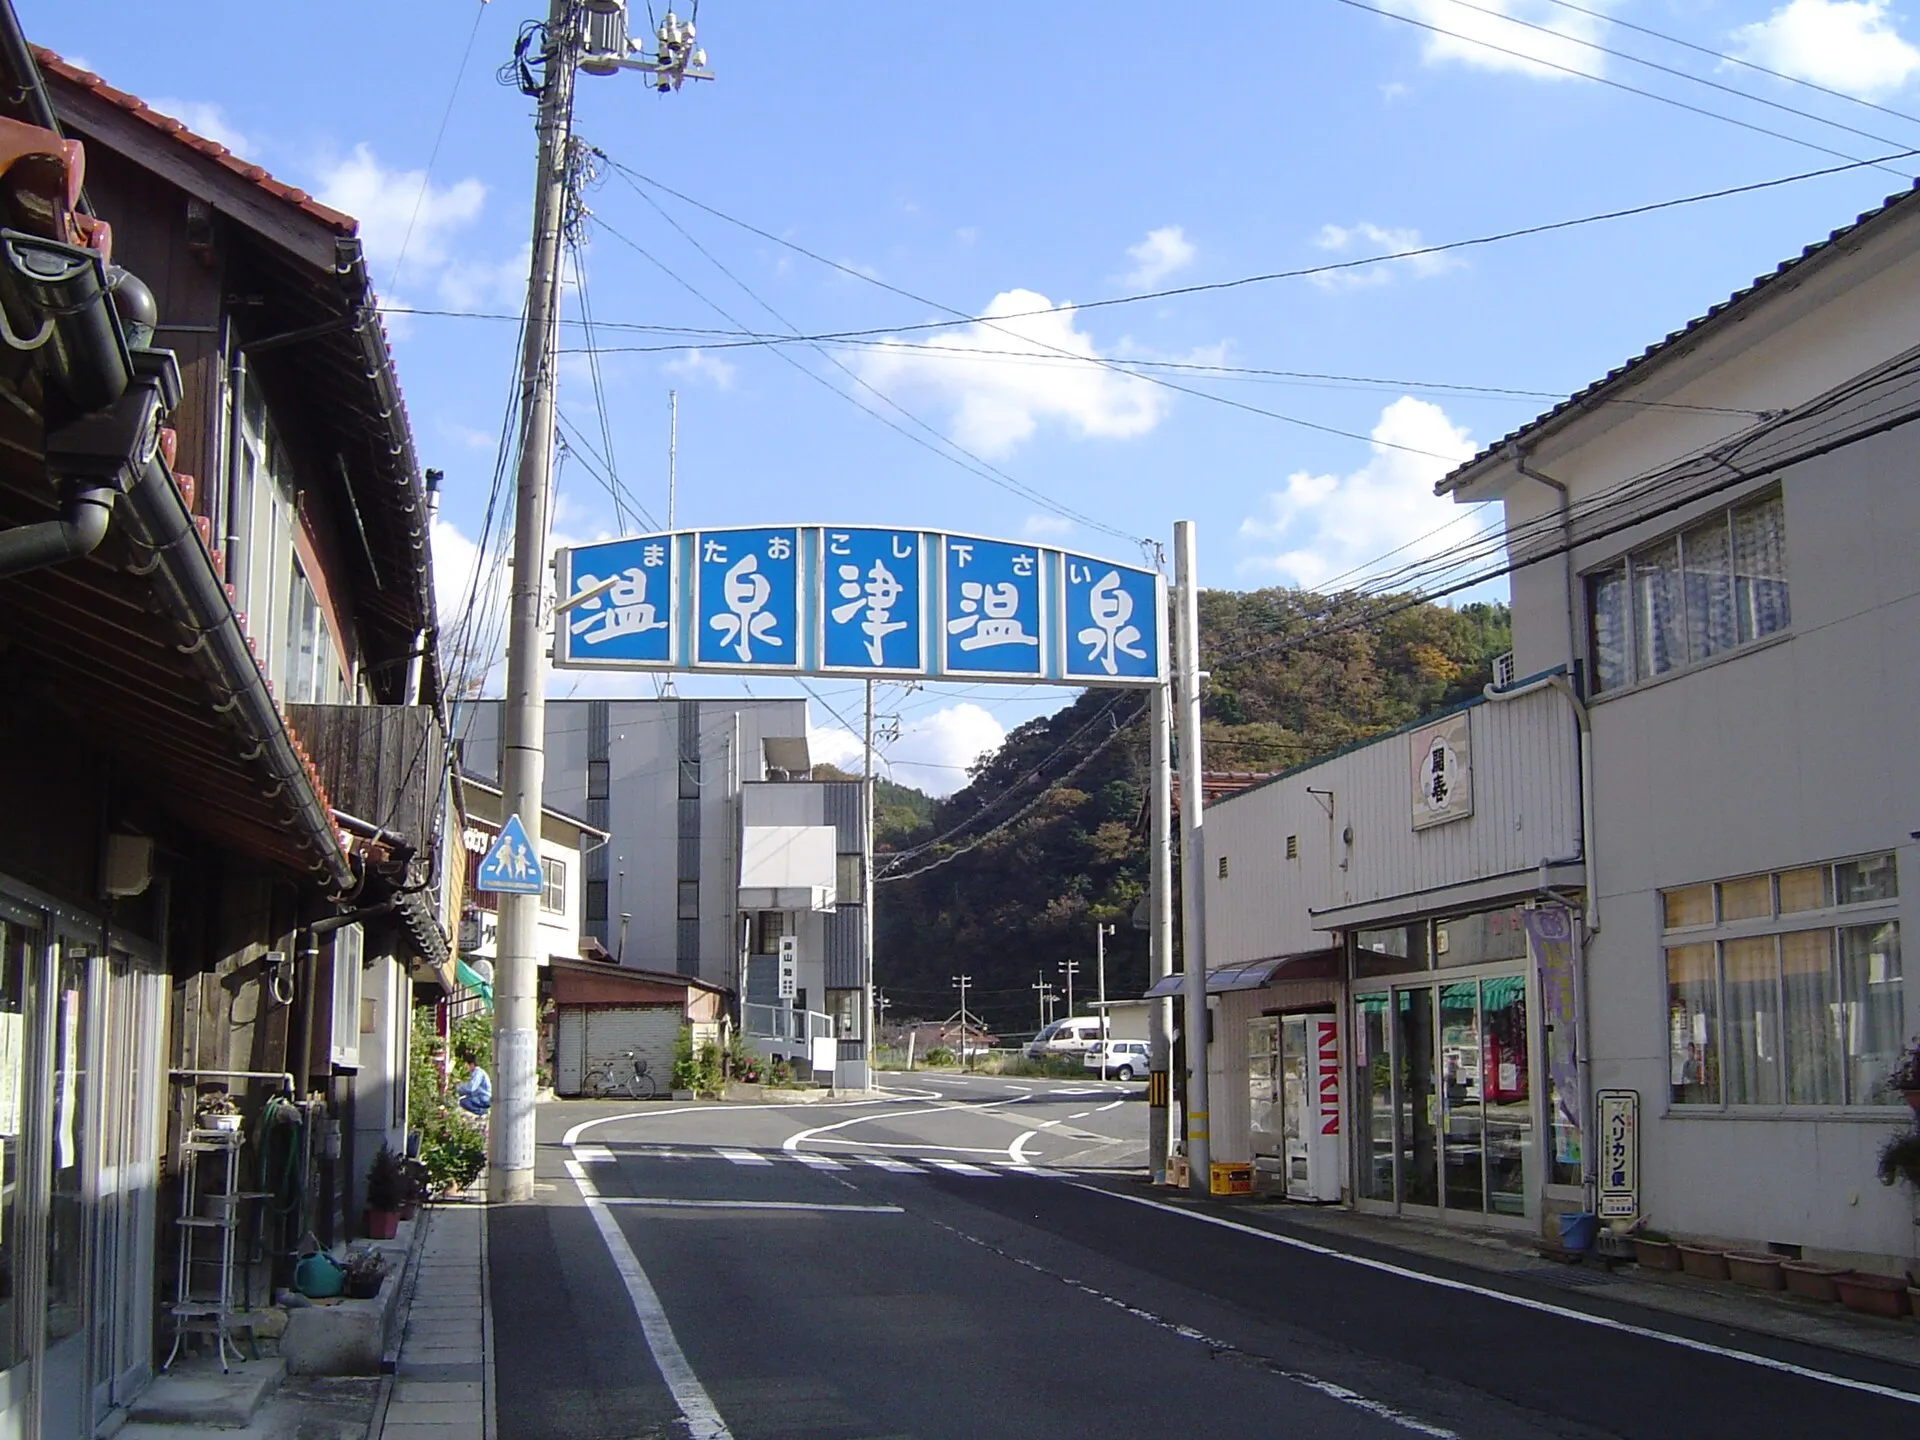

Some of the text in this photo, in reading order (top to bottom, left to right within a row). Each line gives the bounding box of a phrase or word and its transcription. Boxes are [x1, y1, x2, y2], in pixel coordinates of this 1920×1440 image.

[570, 554, 1147, 675] 温泉津温泉
[1611, 1113, 1626, 1187] ペリカン便
